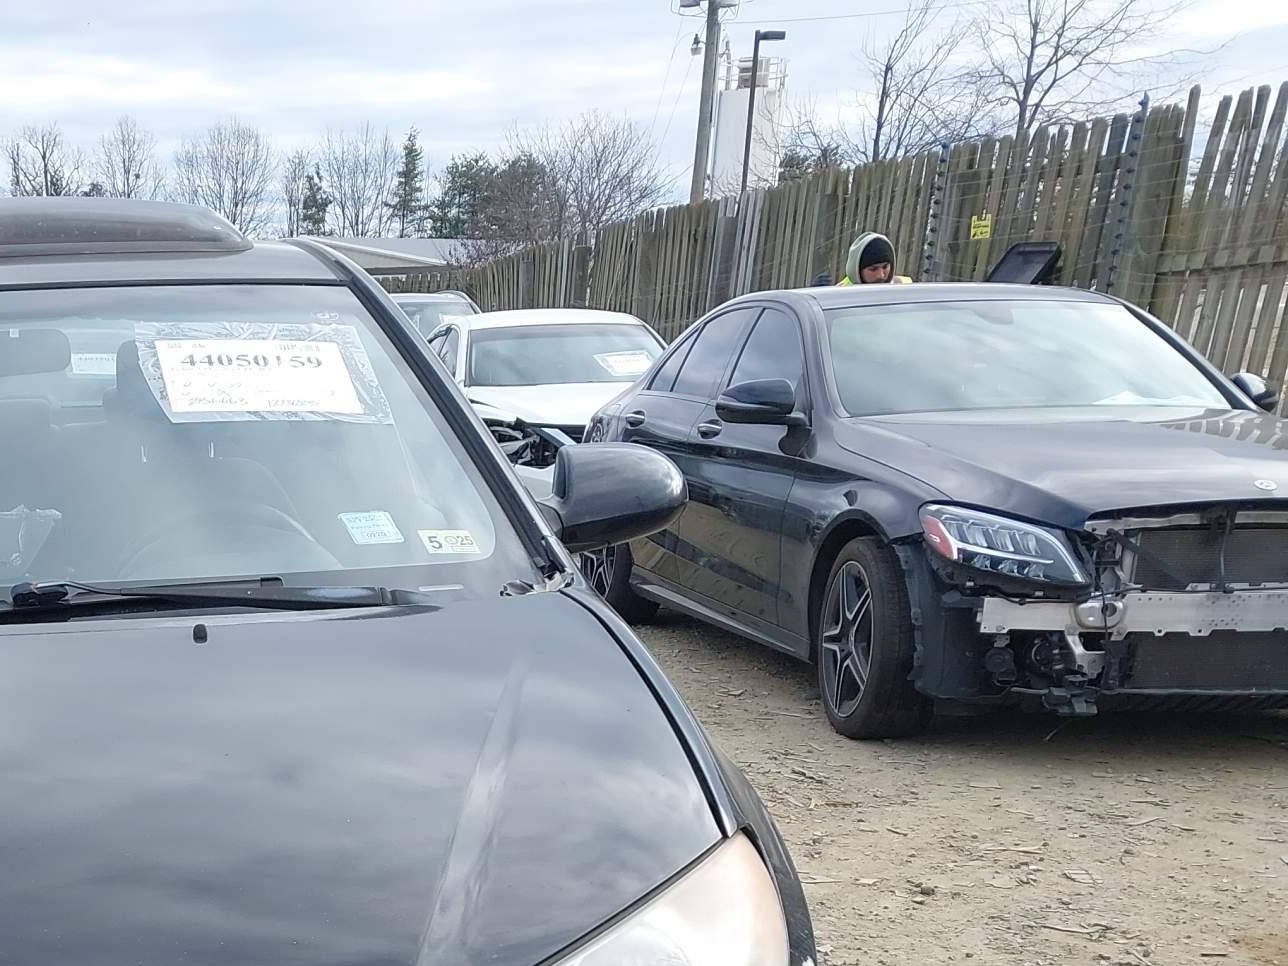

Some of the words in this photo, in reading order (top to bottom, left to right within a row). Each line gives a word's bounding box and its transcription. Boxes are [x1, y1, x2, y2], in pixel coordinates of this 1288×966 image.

[180, 353, 323, 369] 44050159
[427, 535, 443, 550] 5
[455, 535, 474, 546] 25
